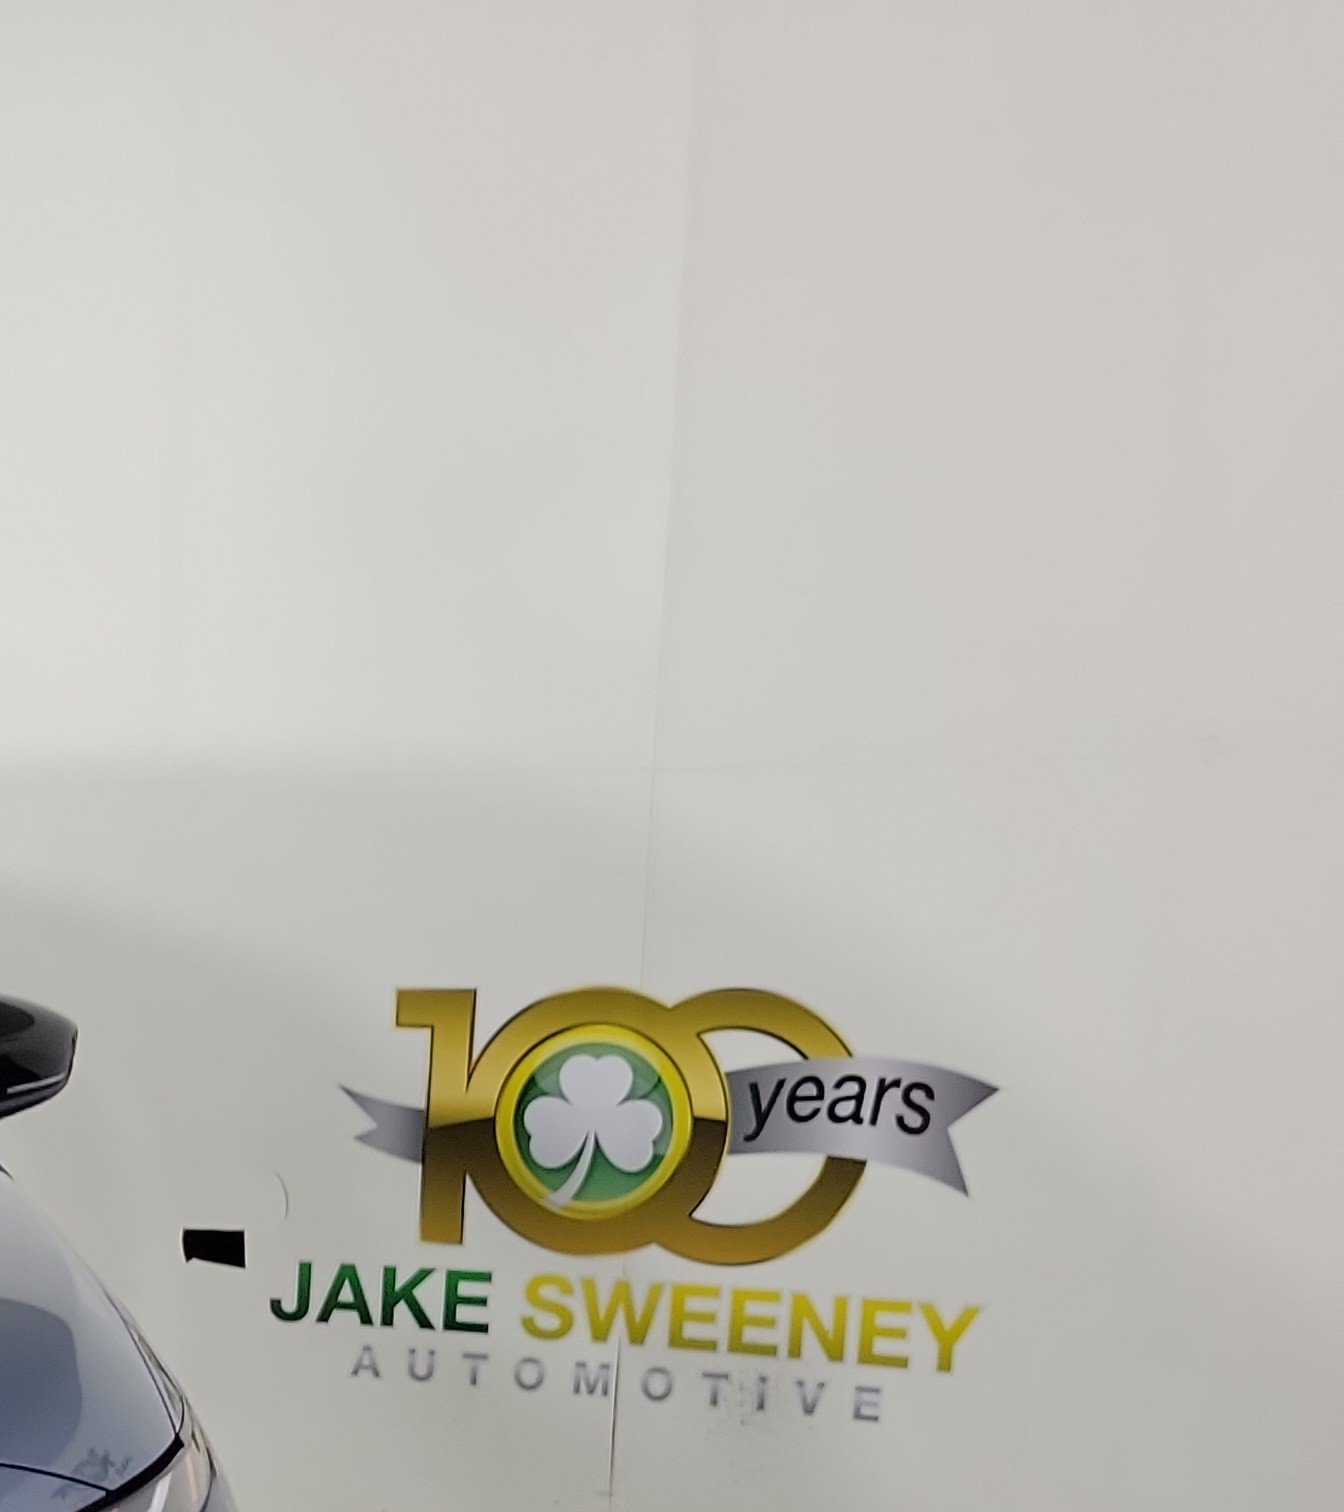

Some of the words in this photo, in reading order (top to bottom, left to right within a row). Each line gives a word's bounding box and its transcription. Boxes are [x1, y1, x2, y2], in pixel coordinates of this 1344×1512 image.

[744, 1073, 935, 1142] years
[269, 1262, 492, 1334] JAKE
[521, 1274, 980, 1374] SWEENEY
[350, 1345, 882, 1424] AUTOMOTIVE
